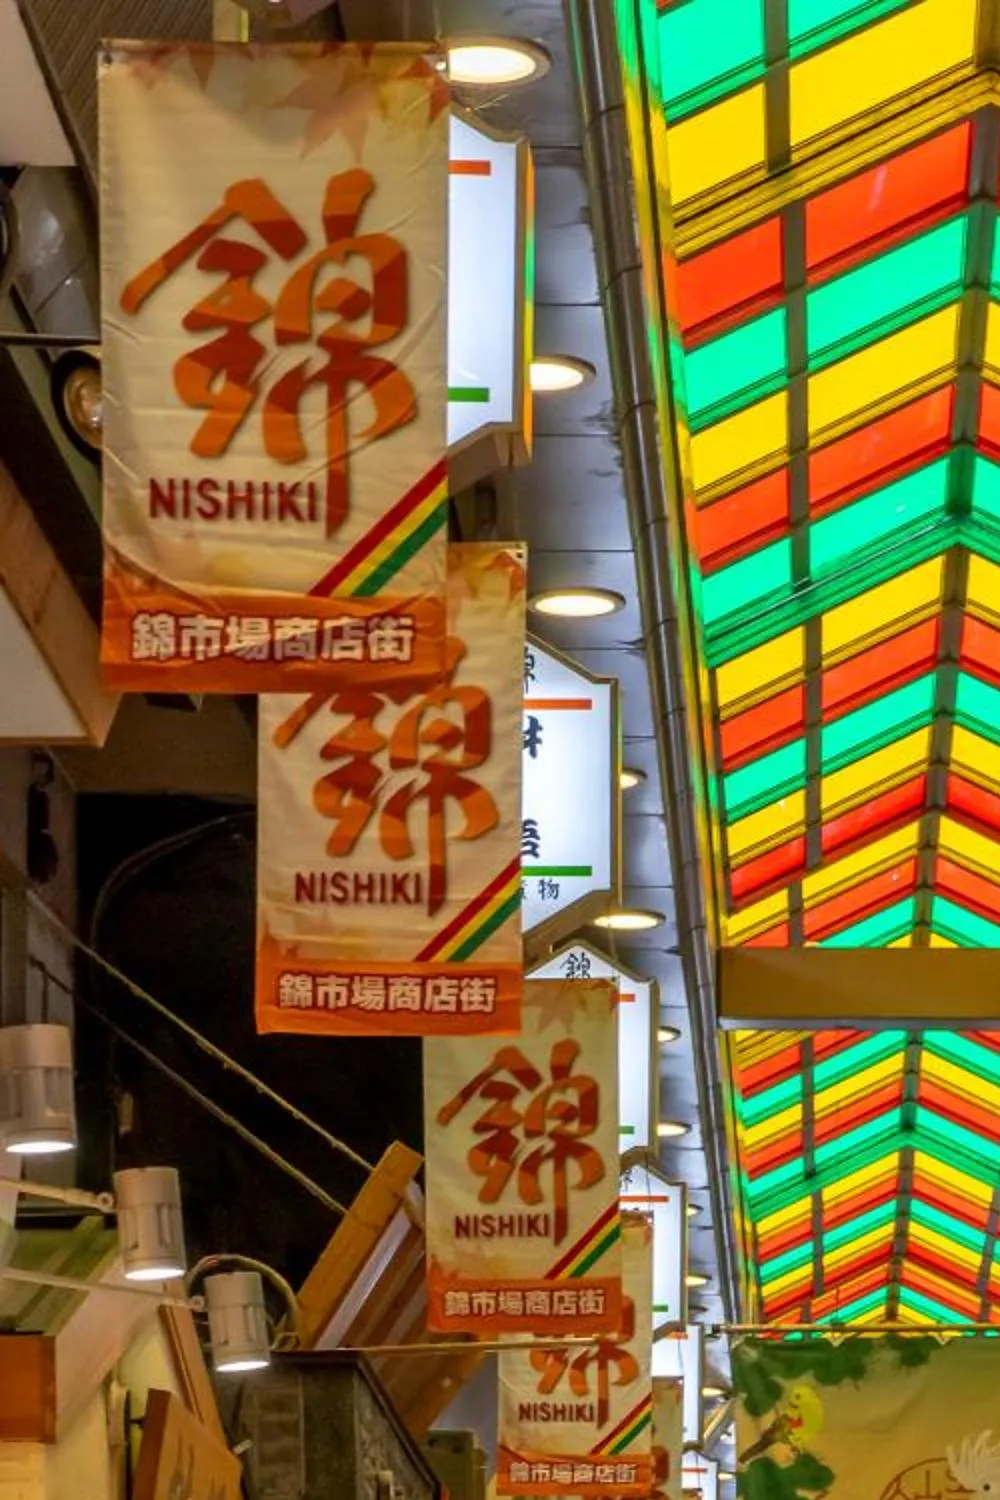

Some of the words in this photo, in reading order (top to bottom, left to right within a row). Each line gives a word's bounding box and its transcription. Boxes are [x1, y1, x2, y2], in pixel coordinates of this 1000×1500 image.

[119, 167, 418, 541] 錦
[148, 477, 318, 523] NISHIKI
[131, 613, 414, 663] 錦市場商店街
[294, 872, 423, 905] NISHIKI
[278, 973, 496, 1013] 錦市場商店街
[436, 1038, 606, 1246] 錦
[454, 1213, 550, 1239] NISHIKI
[443, 1289, 606, 1317] 錦市場商店街
[518, 1402, 596, 1424] NISHIKI
[510, 1462, 638, 1485] 錦市場商店街
